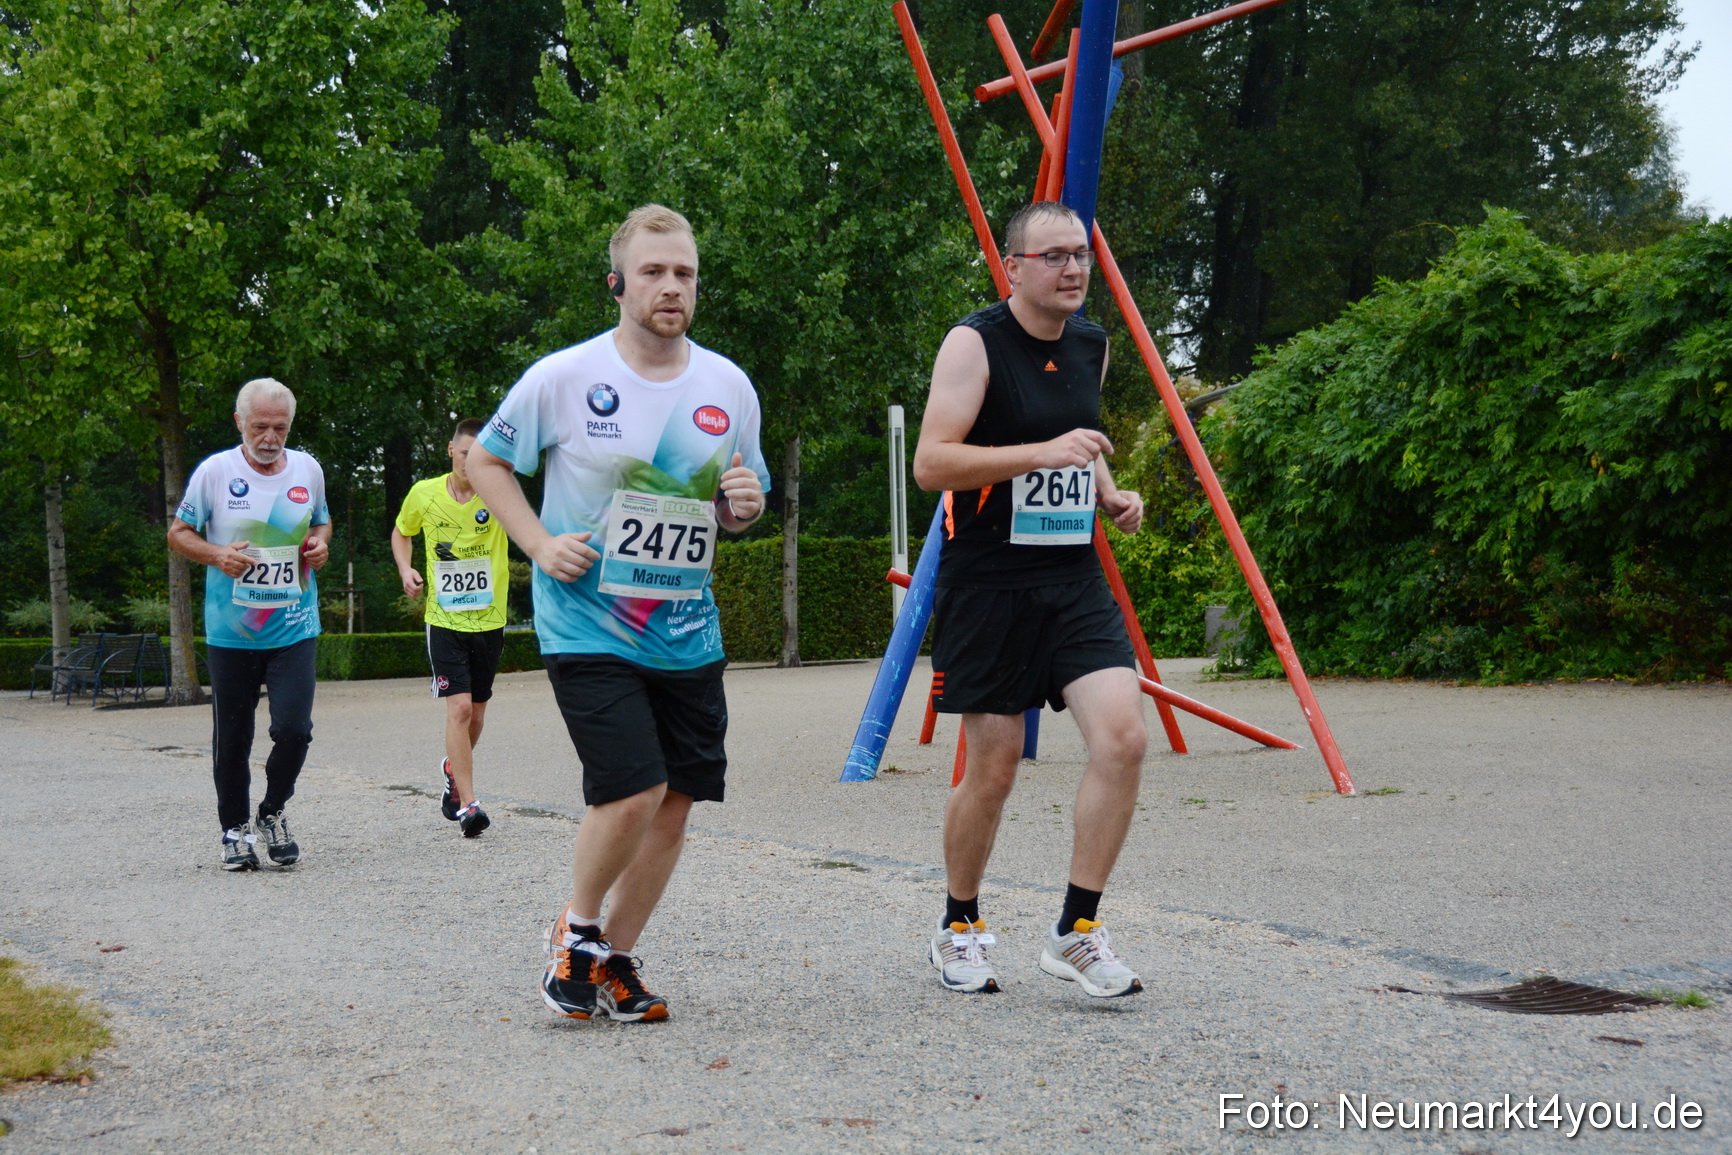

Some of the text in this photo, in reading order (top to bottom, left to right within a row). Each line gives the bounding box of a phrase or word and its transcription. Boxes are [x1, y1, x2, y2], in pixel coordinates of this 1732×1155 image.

[587, 421, 622, 433] PARTL
[698, 411, 727, 429] Hervis
[587, 430, 623, 440] Neumarkt
[1025, 470, 1091, 507] 2647
[621, 502, 658, 514] NeuerMarkt
[1040, 517, 1085, 531] Thomas
[618, 518, 709, 563] 2475
[241, 561, 294, 585] 2275
[441, 570, 488, 593] 2826
[632, 568, 682, 586] Marcus
[248, 590, 289, 600] Raimund
[452, 595, 478, 604] Pascal
[669, 617, 707, 636] Stadtlauf
